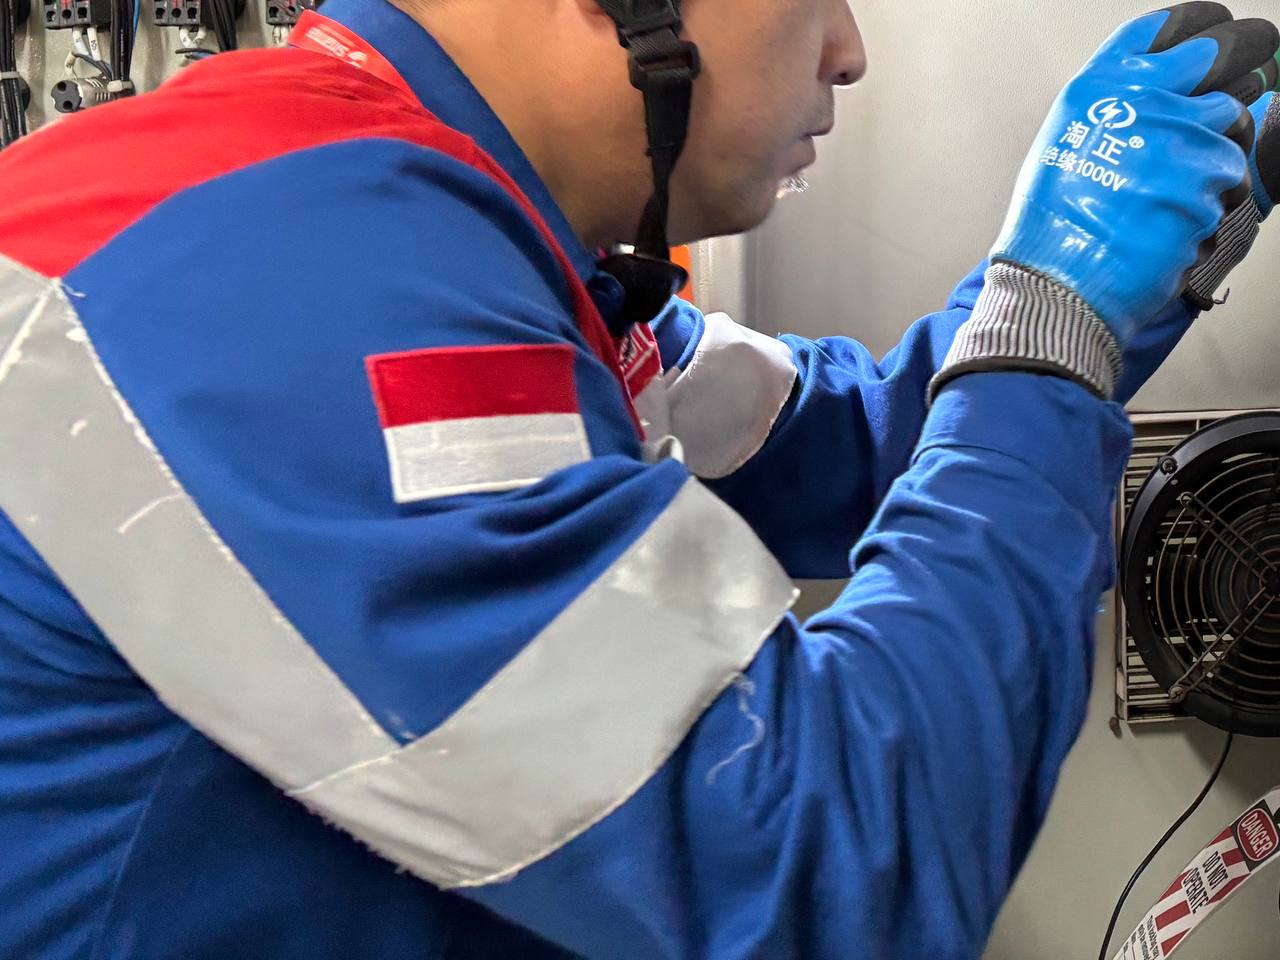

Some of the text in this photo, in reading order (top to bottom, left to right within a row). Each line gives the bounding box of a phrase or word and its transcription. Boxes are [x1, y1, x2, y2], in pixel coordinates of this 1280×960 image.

[1241, 813, 1273, 858] DANGER
[1182, 867, 1209, 914] OPERATE
[1202, 850, 1229, 890] DO NOT
